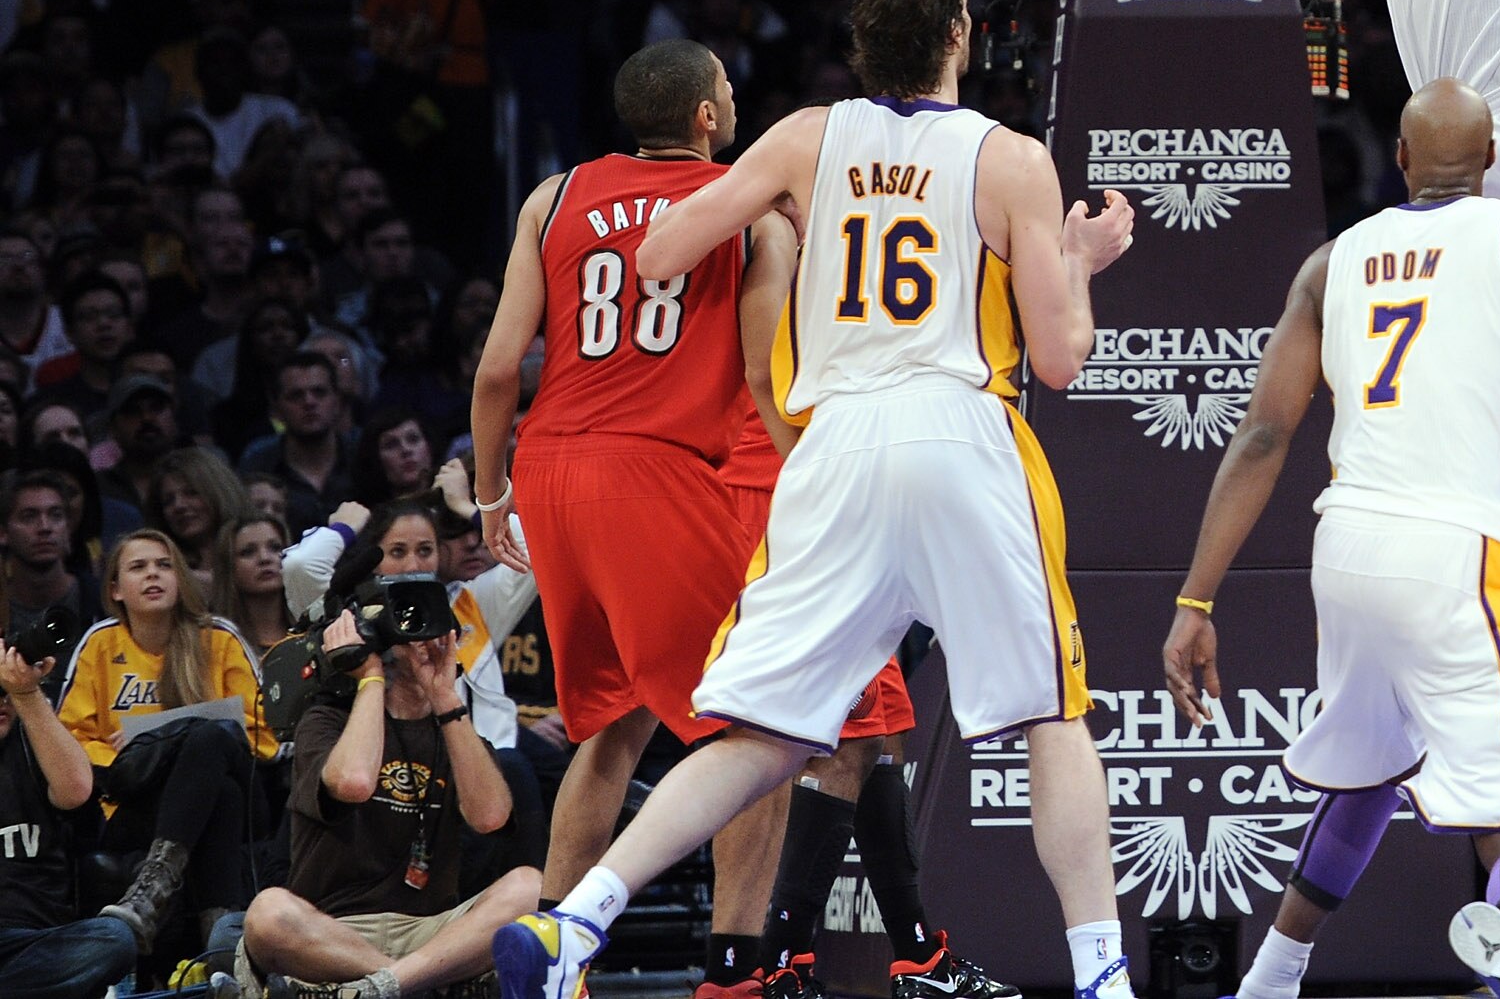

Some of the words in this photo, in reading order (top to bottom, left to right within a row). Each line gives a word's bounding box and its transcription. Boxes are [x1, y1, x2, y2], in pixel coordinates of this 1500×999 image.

[1088, 128, 1289, 156] PECHANGA
[848, 162, 931, 202] GASOL
[1088, 162, 1181, 181] RESORT
[1201, 161, 1291, 181] CASINO
[586, 197, 671, 238] BATU
[835, 214, 939, 325] 16
[1365, 248, 1443, 287] ODOM
[578, 249, 690, 360] 88
[1090, 327, 1277, 361] ECHAN
[1364, 297, 1428, 410] 7
[502, 634, 540, 675] RS
[111, 673, 160, 711] LAK
[971, 767, 1172, 807] RERT
